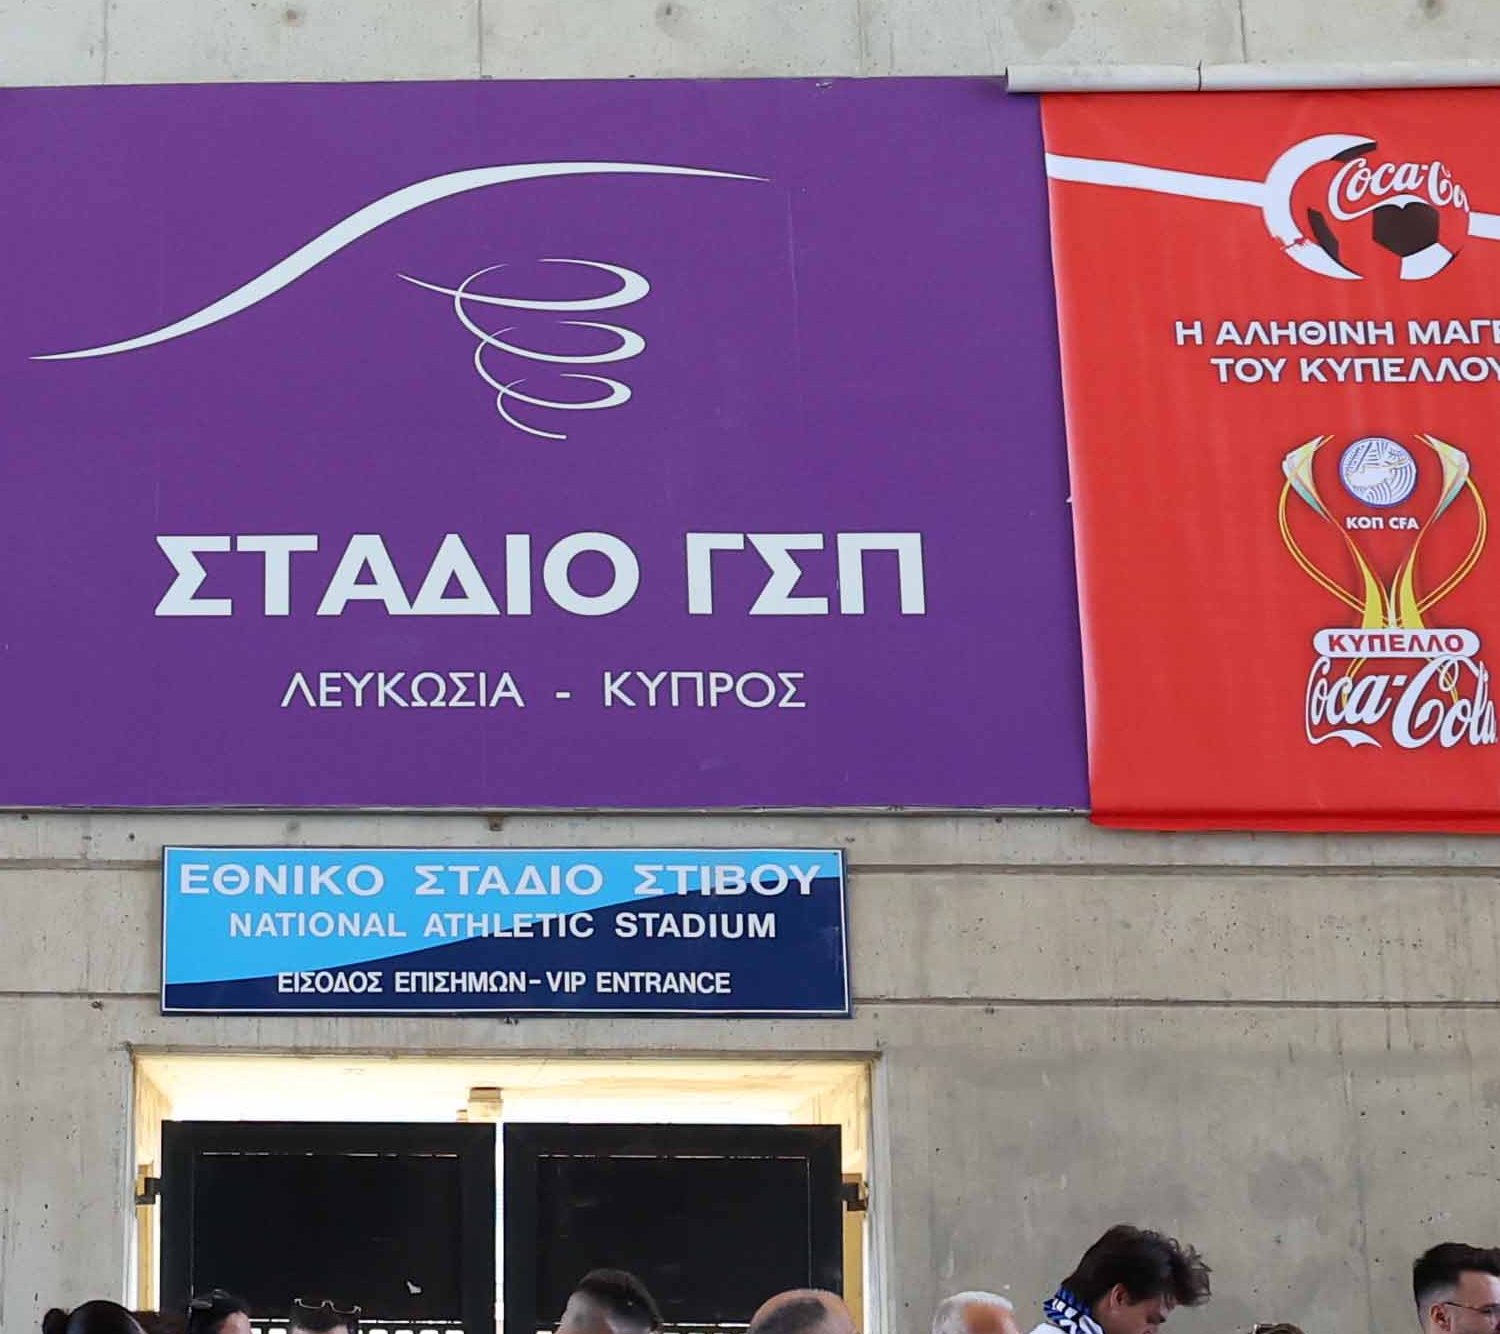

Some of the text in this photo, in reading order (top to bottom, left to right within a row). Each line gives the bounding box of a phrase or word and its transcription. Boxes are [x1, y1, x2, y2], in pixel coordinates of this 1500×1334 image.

[1174, 321, 1202, 346] Η
[1215, 320, 1396, 346] ΑΛΗΘΙΝΗ
[1210, 357, 1282, 383] ΤΟΥ
[1346, 516, 1420, 531] ΚΟΠ CFA
[154, 531, 926, 616] ΣΤΑΔΙΟ ΓΣΠ
[1328, 633, 1465, 654] ΚΥΠΕΛΛΟ
[280, 671, 524, 708] ΛΕΥΚΩΣΙΑ
[602, 671, 807, 709] ΚΥΠΡΟΣ
[1306, 656, 1498, 748] Coca-Cola
[179, 863, 823, 897] ΕΘΝΙΚΟ ΣΤΑΔΙΟ ΣΤΙΒΟΥ
[228, 911, 776, 940] NATIONAL ATHLETIC STADIUM
[277, 970, 383, 994] ΕΙΣΟΔΟΣ
[596, 971, 732, 995] ENTRANCE
